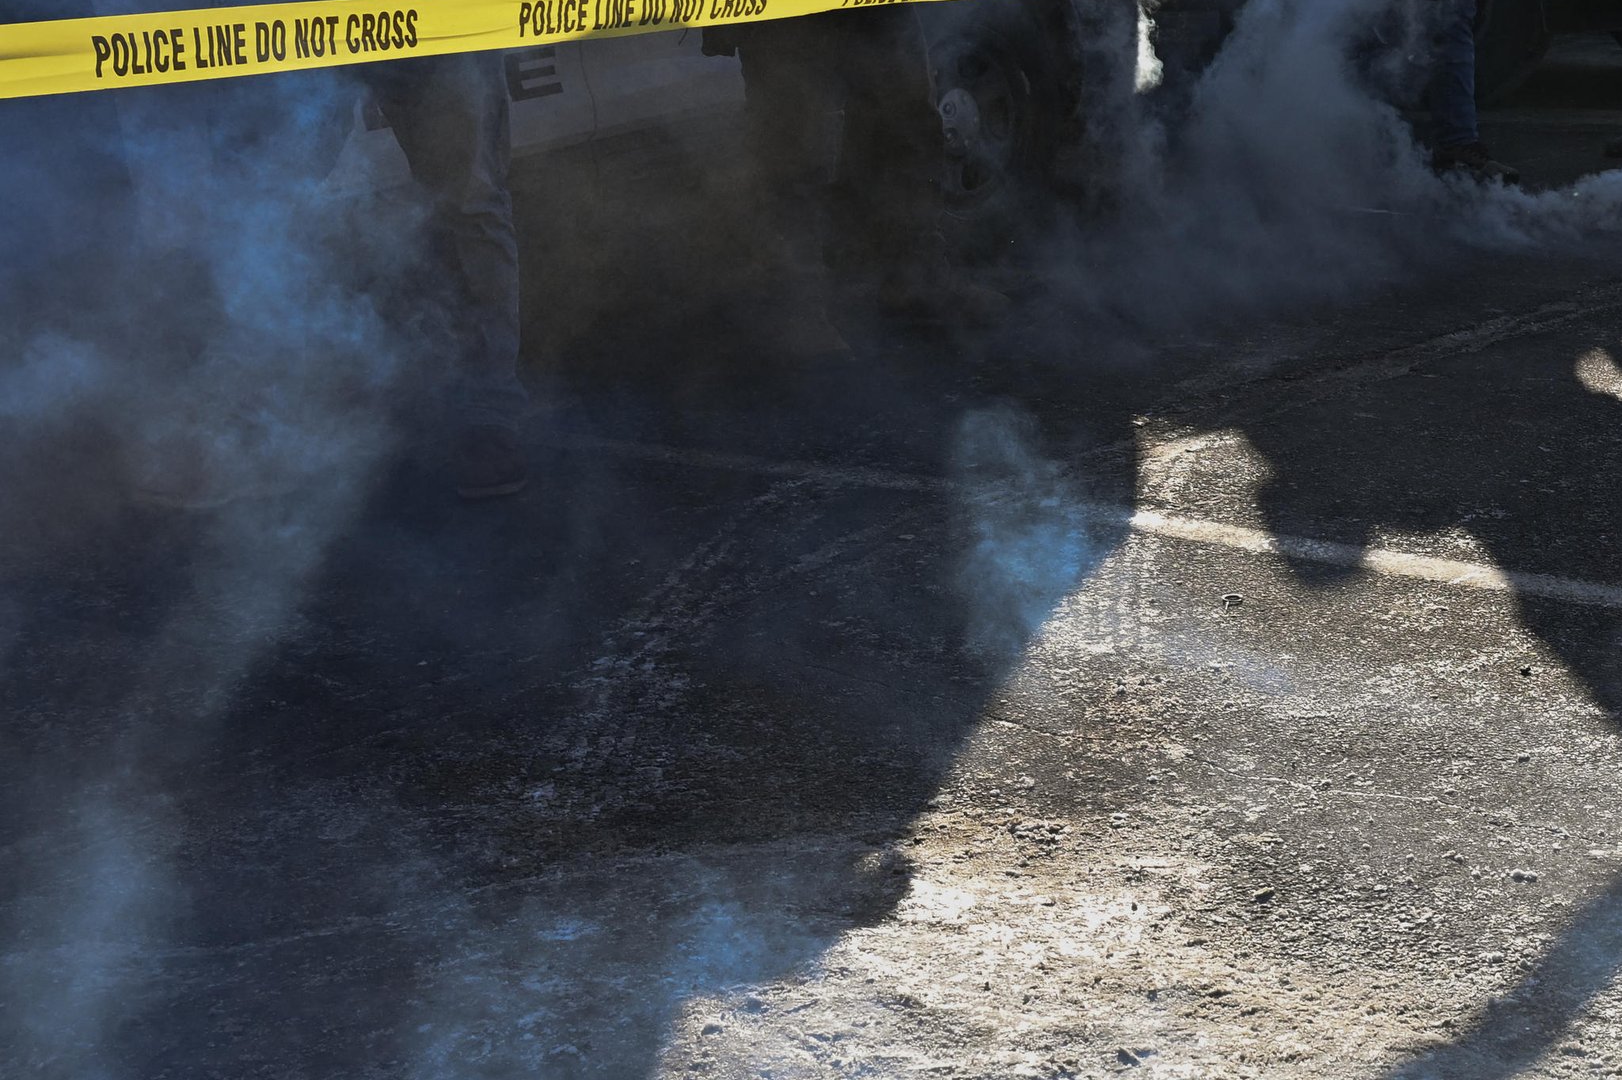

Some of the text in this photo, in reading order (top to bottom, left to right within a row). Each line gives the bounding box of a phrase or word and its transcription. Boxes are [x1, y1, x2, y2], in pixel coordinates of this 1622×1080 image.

[91, 9, 419, 78] POLICE LINE DO NOT CROSS
